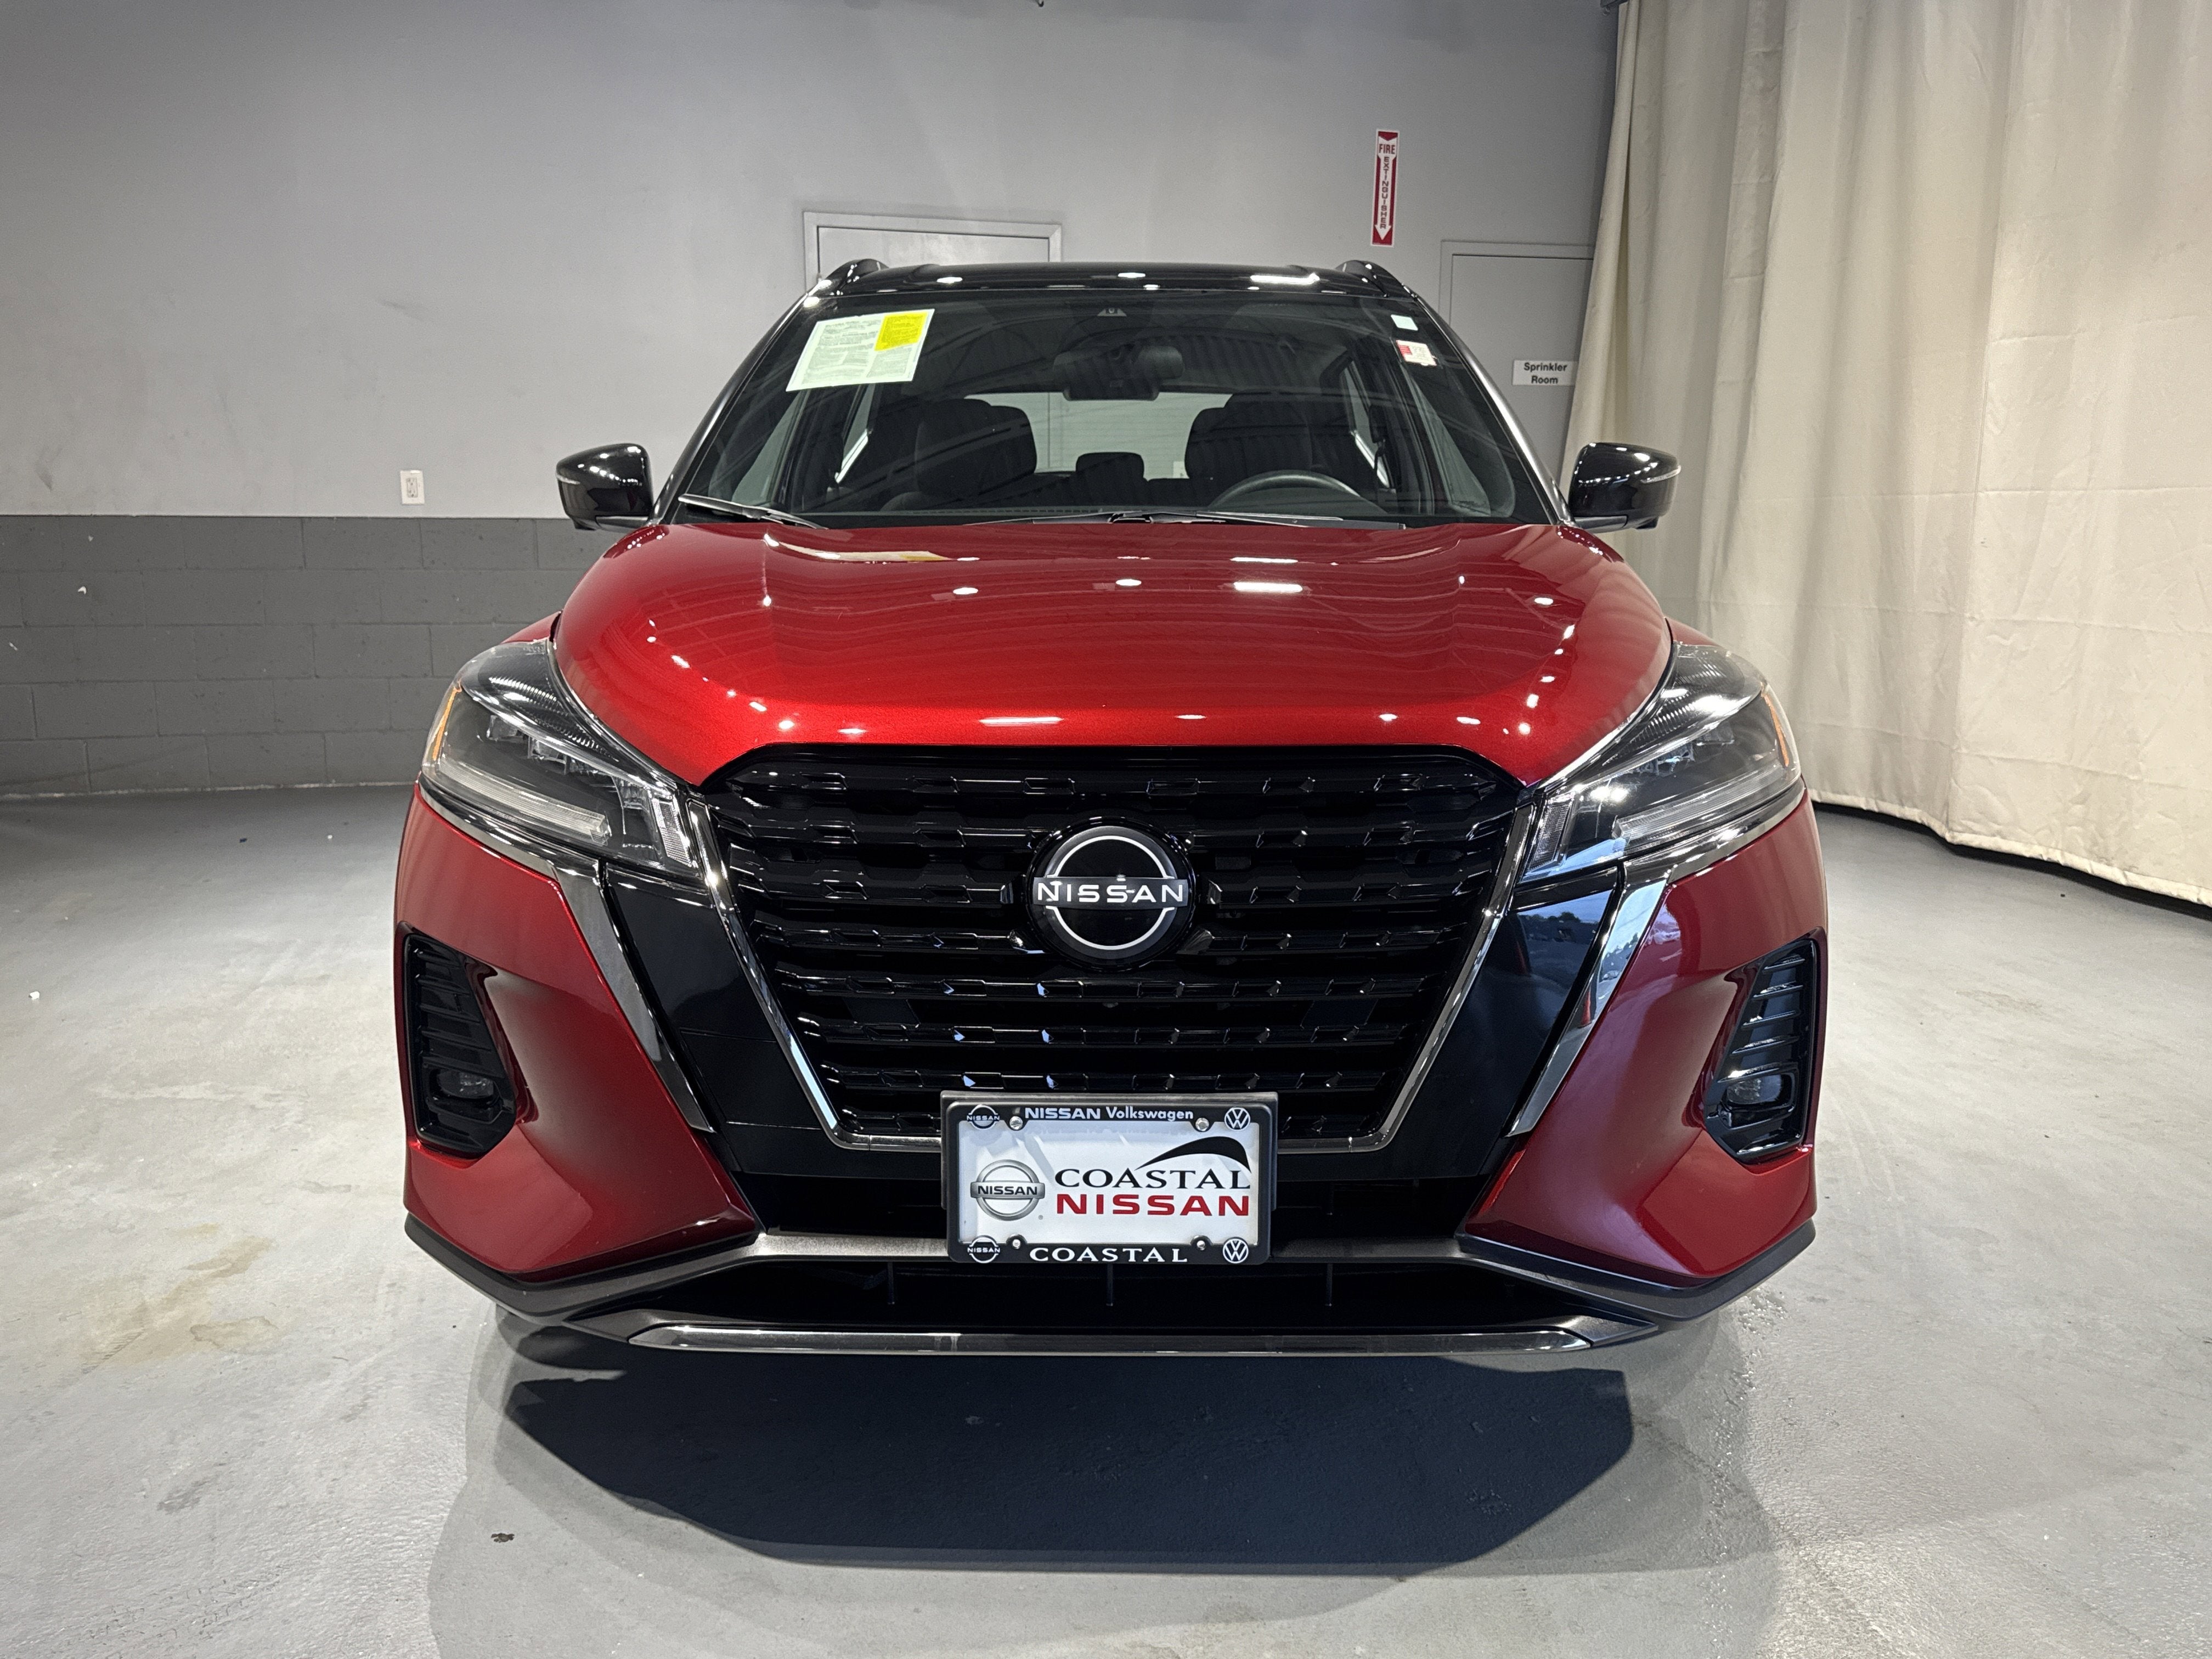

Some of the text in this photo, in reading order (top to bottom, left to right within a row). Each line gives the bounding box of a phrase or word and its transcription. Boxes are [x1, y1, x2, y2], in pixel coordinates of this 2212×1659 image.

[1379, 144, 1395, 154] FIRE
[1380, 156, 1390, 229] EXTINGUISHER
[1523, 363, 1567, 373] Sprinkler
[1531, 376, 1558, 384] Room
[1037, 882, 1183, 903] NISSAN
[1025, 1105, 1194, 1122] NISSAN Volkswagen
[1054, 1167, 1250, 1189] COASTAL
[977, 1186, 1037, 1195] NISSAN
[1057, 1194, 1249, 1216] NISSAN
[1029, 1246, 1188, 1262] COASTAL
